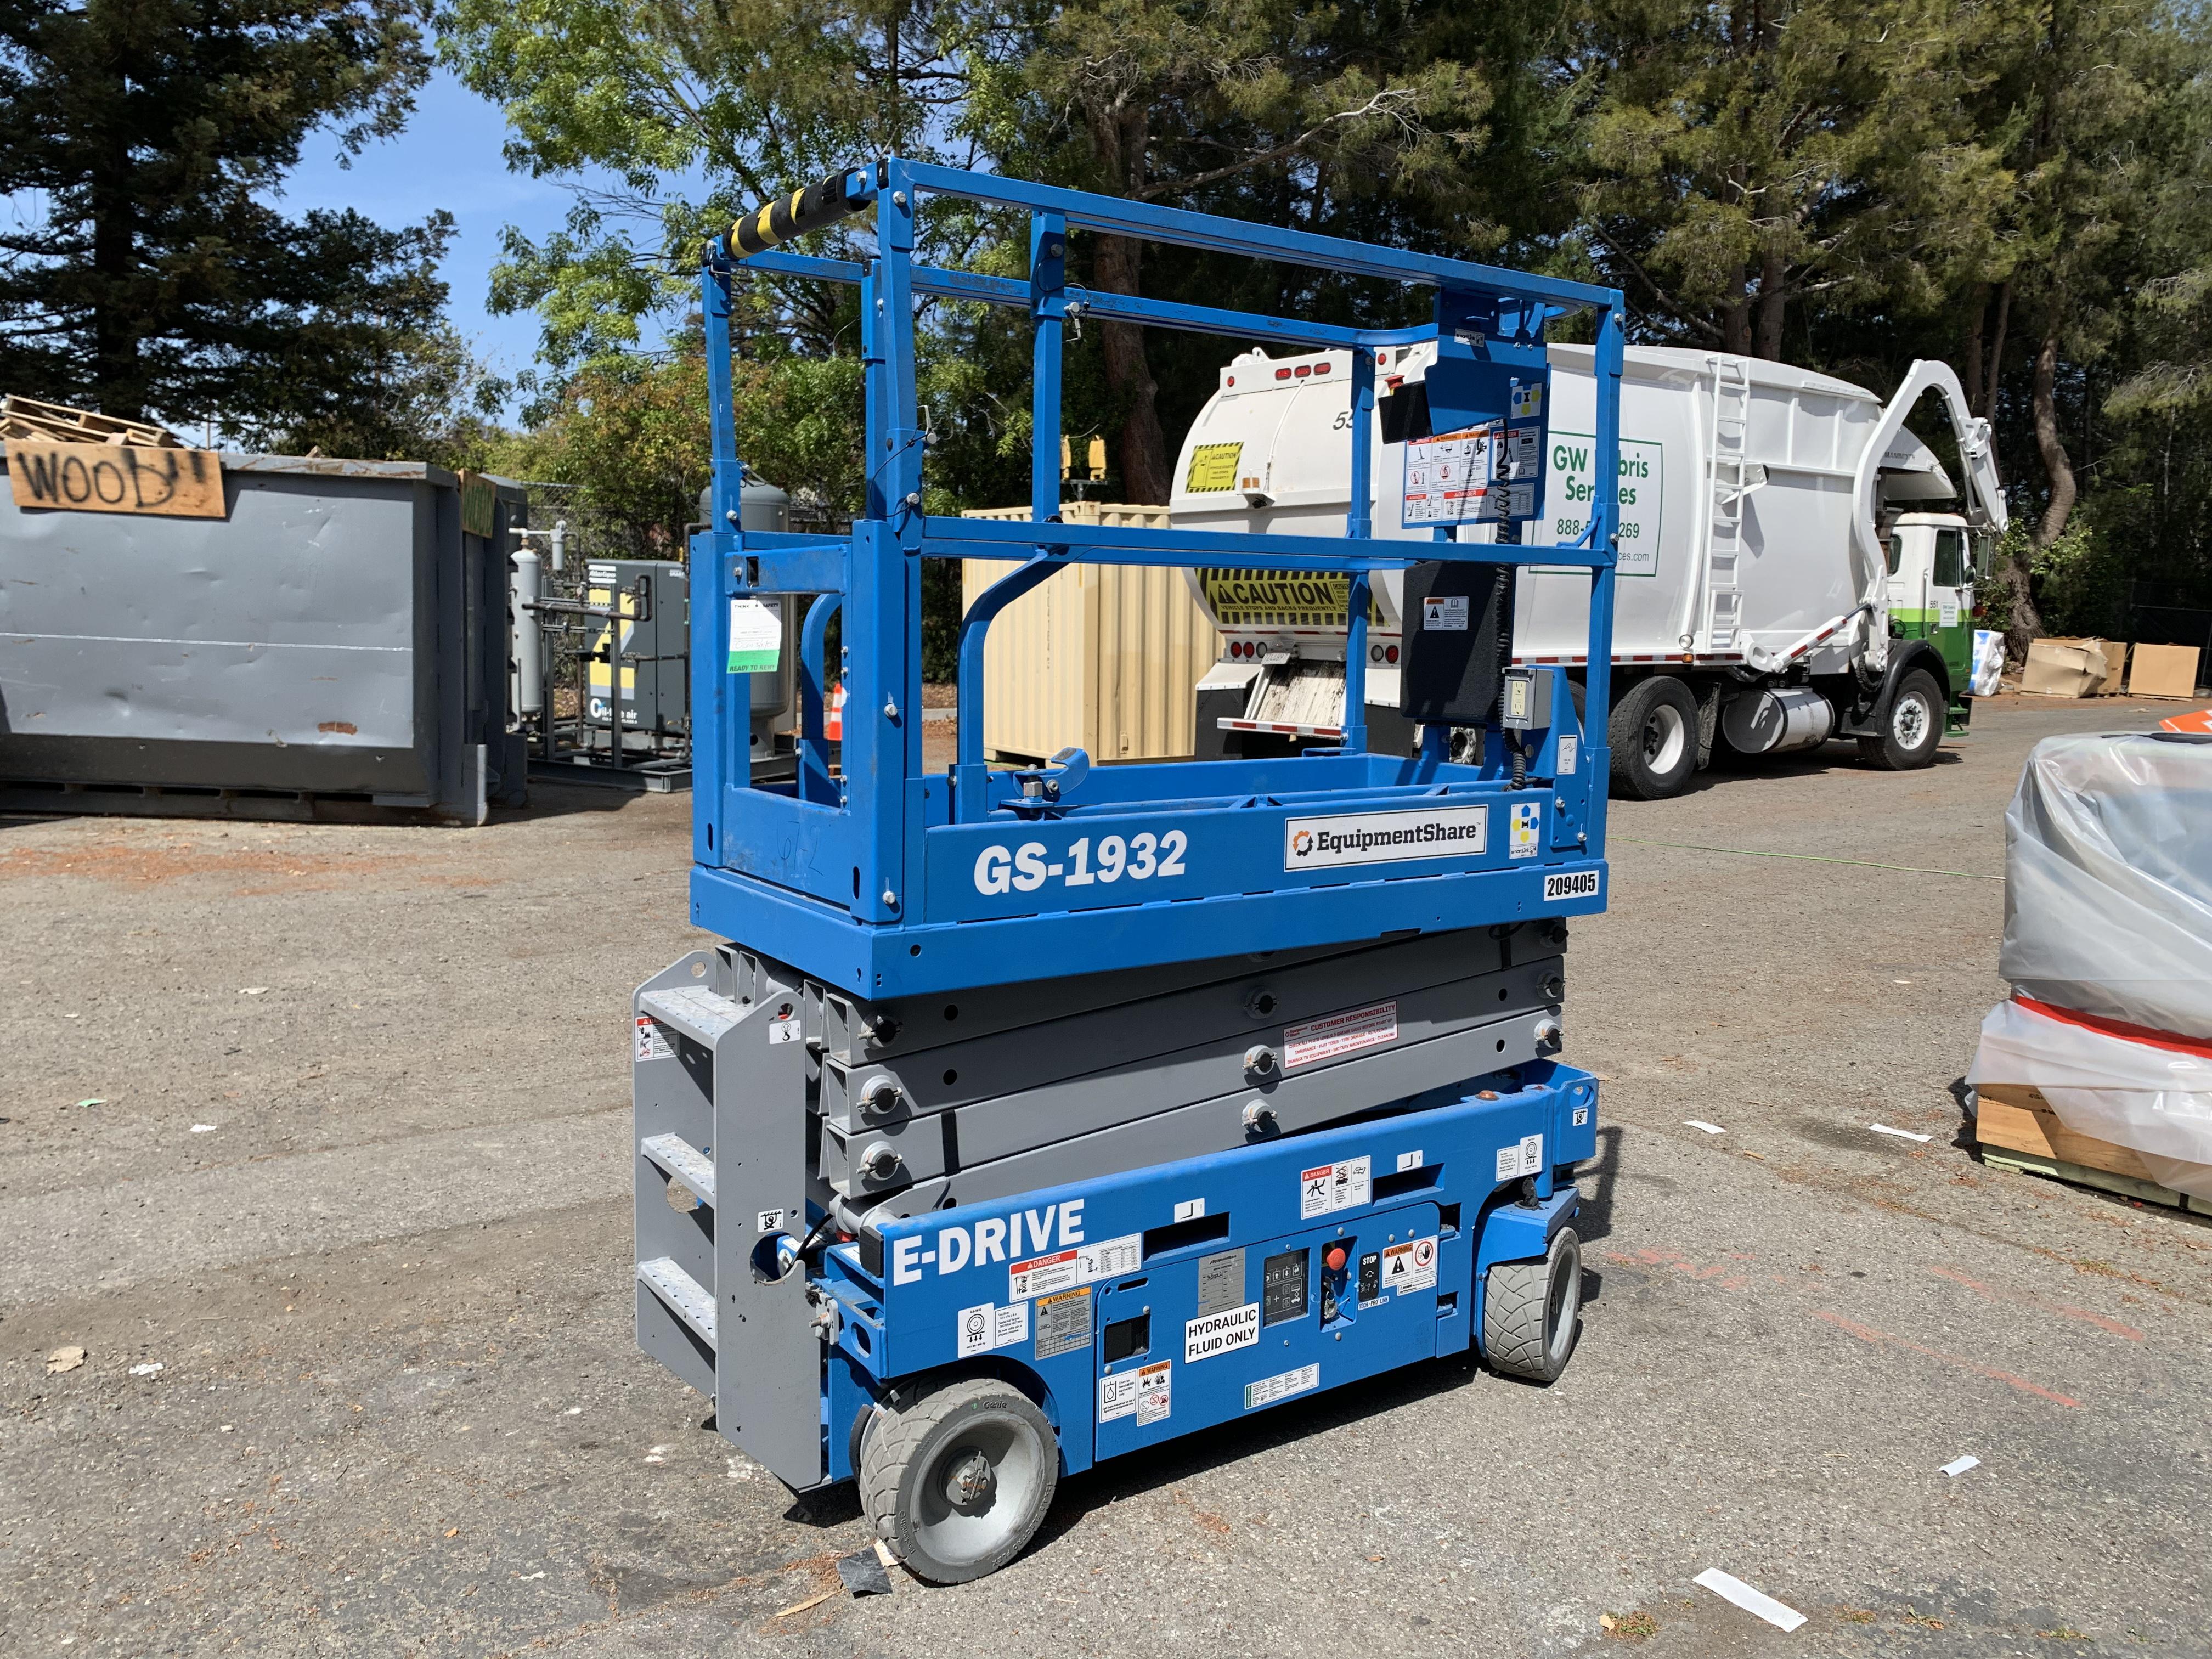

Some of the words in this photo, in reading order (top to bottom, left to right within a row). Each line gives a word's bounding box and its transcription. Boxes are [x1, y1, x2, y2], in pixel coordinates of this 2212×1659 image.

[1553, 445, 1588, 472] GW
[1618, 450, 1649, 478] bris
[1565, 475, 1637, 505] Seres
[1233, 583, 1335, 605] CAUTION
[626, 709, 637, 719] air
[1317, 823, 1476, 854] EquipmentShare
[974, 830, 1187, 895] GS-1932
[1547, 874, 1595, 896] 209405
[1311, 1018, 1344, 1031] CUSTOMER
[1345, 1005, 1396, 1023] RESPONSIBILITY
[1295, 1046, 1317, 1055] INSURANCE
[1368, 1027, 1387, 1035] REFUELING
[1309, 1049, 1330, 1059] EQUIPMENT
[1333, 1044, 1349, 1052] BATTERY
[1349, 1037, 1375, 1048] MAINTENANCE
[1377, 1032, 1395, 1040] CLEANING
[1310, 1169, 1330, 1178] DANGER
[893, 1198, 1084, 1286] E-DRIVE
[1390, 1245, 1412, 1256] WARNING
[1033, 1255, 1061, 1268] DANGER
[1363, 1255, 1377, 1265] STOP
[1053, 1290, 1080, 1302] WARNING
[1189, 1309, 1256, 1338] HYDRAULIC
[1189, 1337, 1222, 1357] FLUID
[1226, 1327, 1256, 1346] ONLY
[983, 1400, 1007, 1409] Genie
[1012, 1513, 1041, 1551] ELECTRO
[992, 1549, 1012, 1567] FLEX
